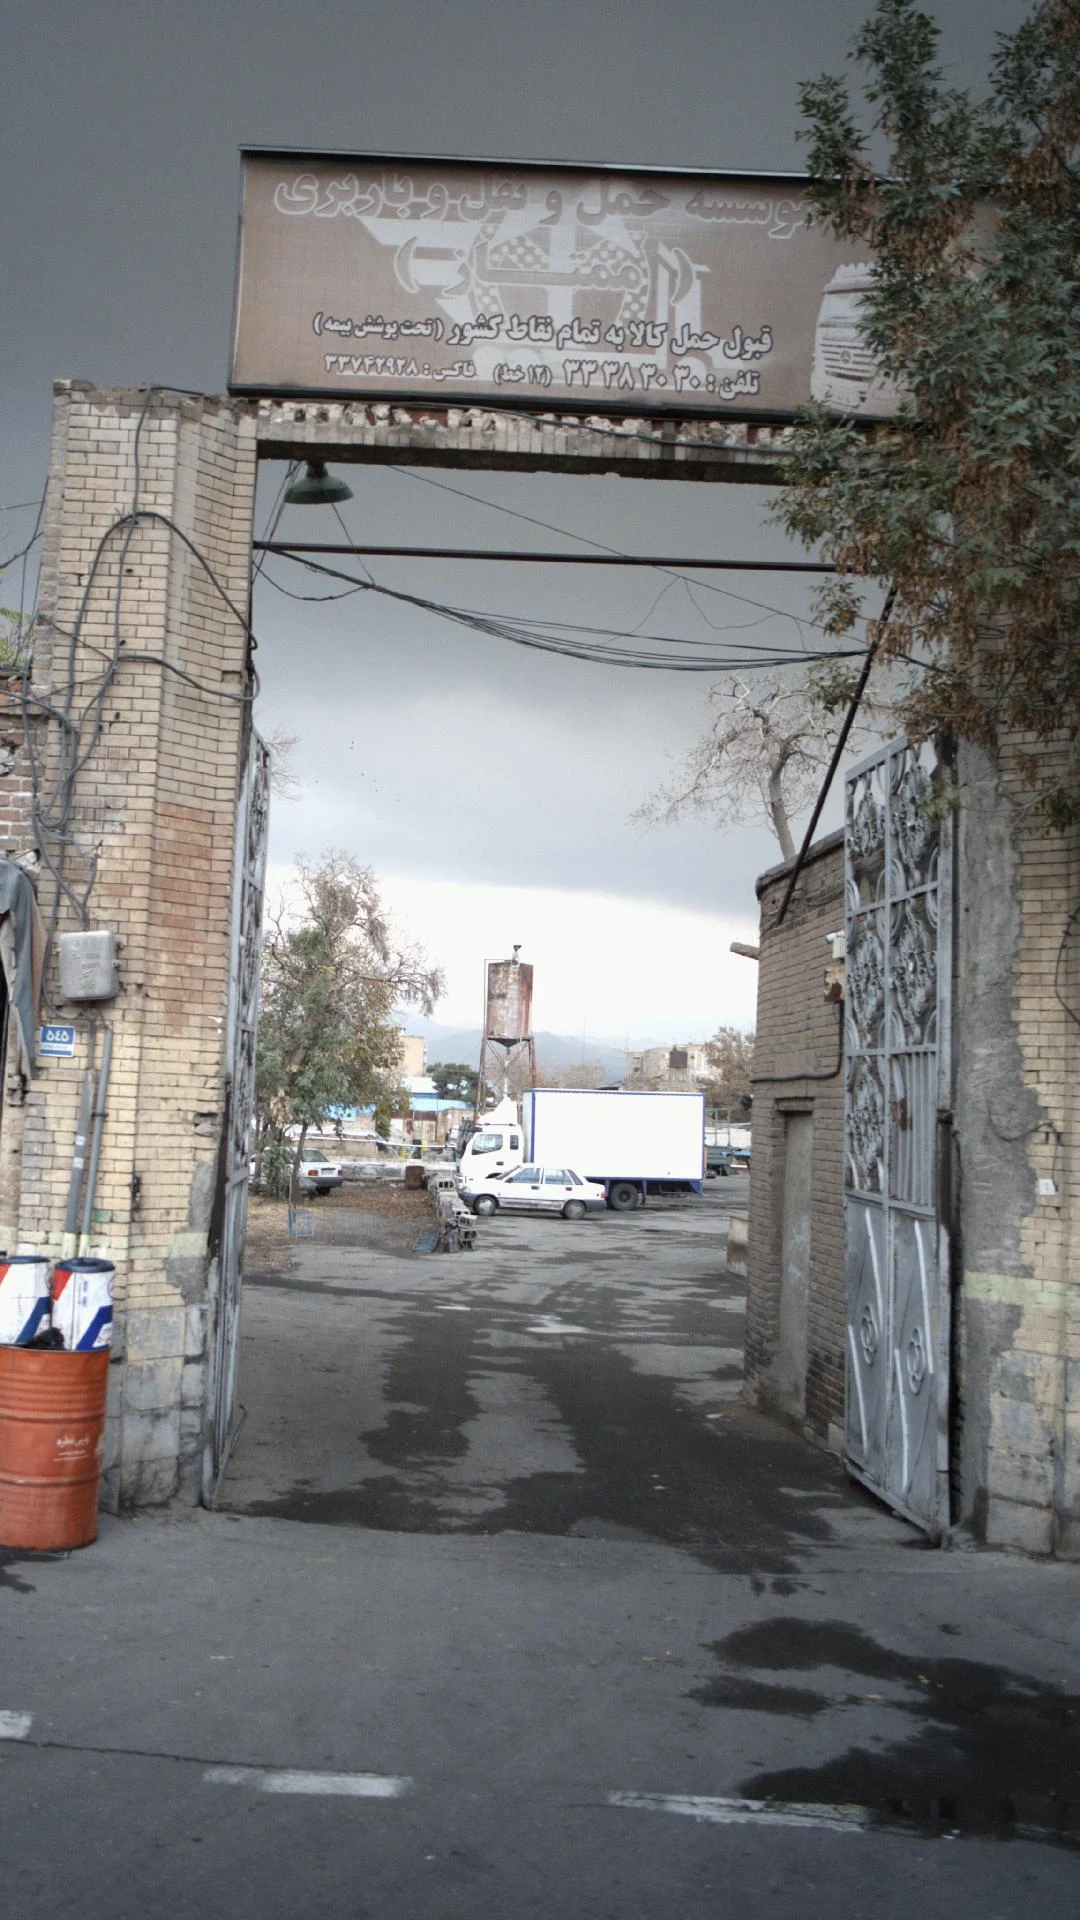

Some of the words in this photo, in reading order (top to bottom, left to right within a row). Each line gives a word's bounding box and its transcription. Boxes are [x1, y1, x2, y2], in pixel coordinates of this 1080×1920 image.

[274, 172, 414, 219] باربری
[420, 183, 449, 220] و
[458, 172, 529, 223] نقل
[539, 190, 563, 226] و
[576, 178, 672, 226] حمل
[446, 313, 503, 346] کشور
[506, 314, 554, 342] نقاط
[556, 317, 601, 350] تمام
[603, 323, 626, 352] به
[629, 321, 668, 348] کالا
[670, 323, 720, 356] حمل
[723, 324, 773, 360] قبول
